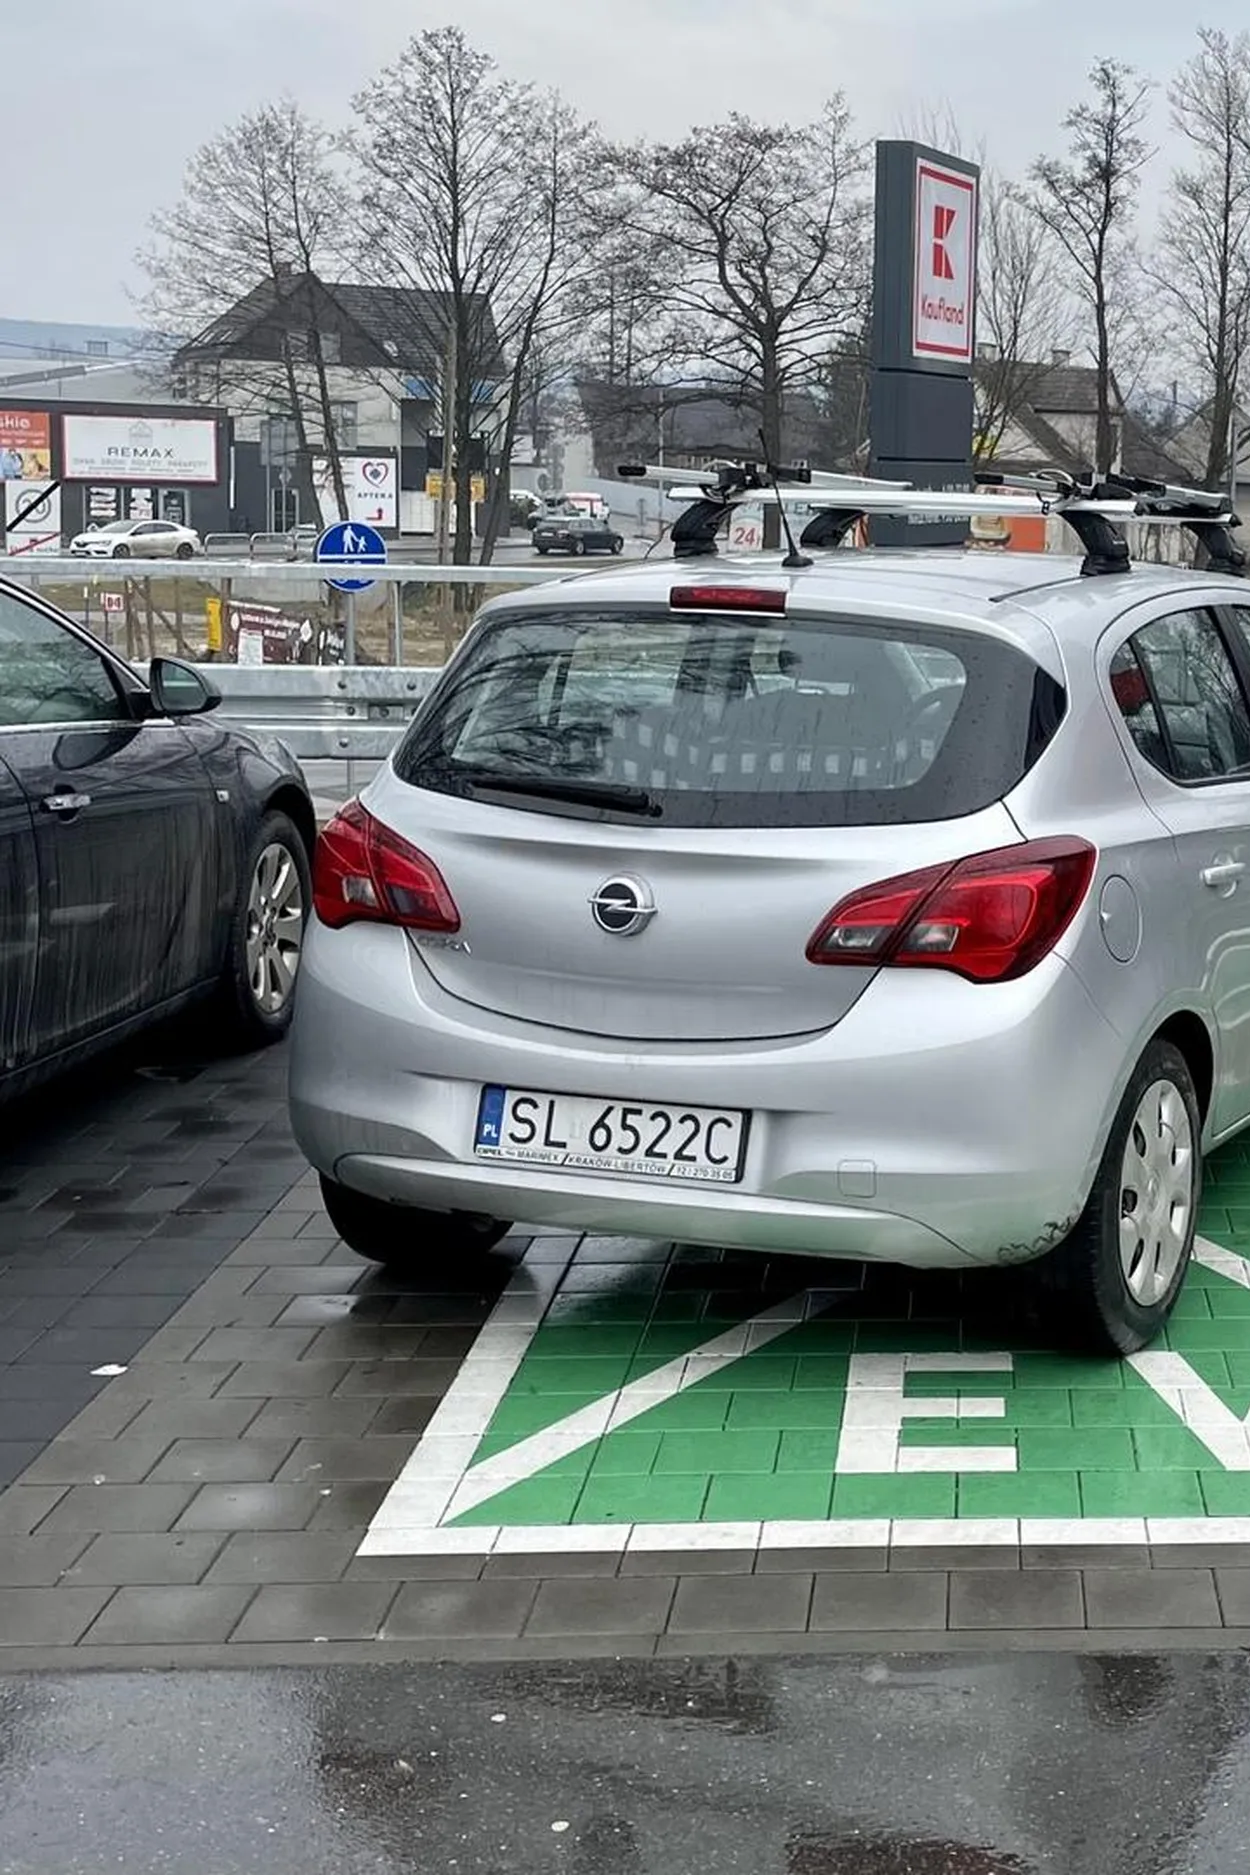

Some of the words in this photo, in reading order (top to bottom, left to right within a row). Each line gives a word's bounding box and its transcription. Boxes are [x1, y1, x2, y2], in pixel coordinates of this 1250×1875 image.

[932, 205, 956, 280] K
[920, 294, 964, 325] Kaufland
[107, 447, 174, 458] REMAX
[483, 1123, 497, 1138] PL
[508, 1097, 566, 1149] SL
[588, 1105, 733, 1165] 6522C
